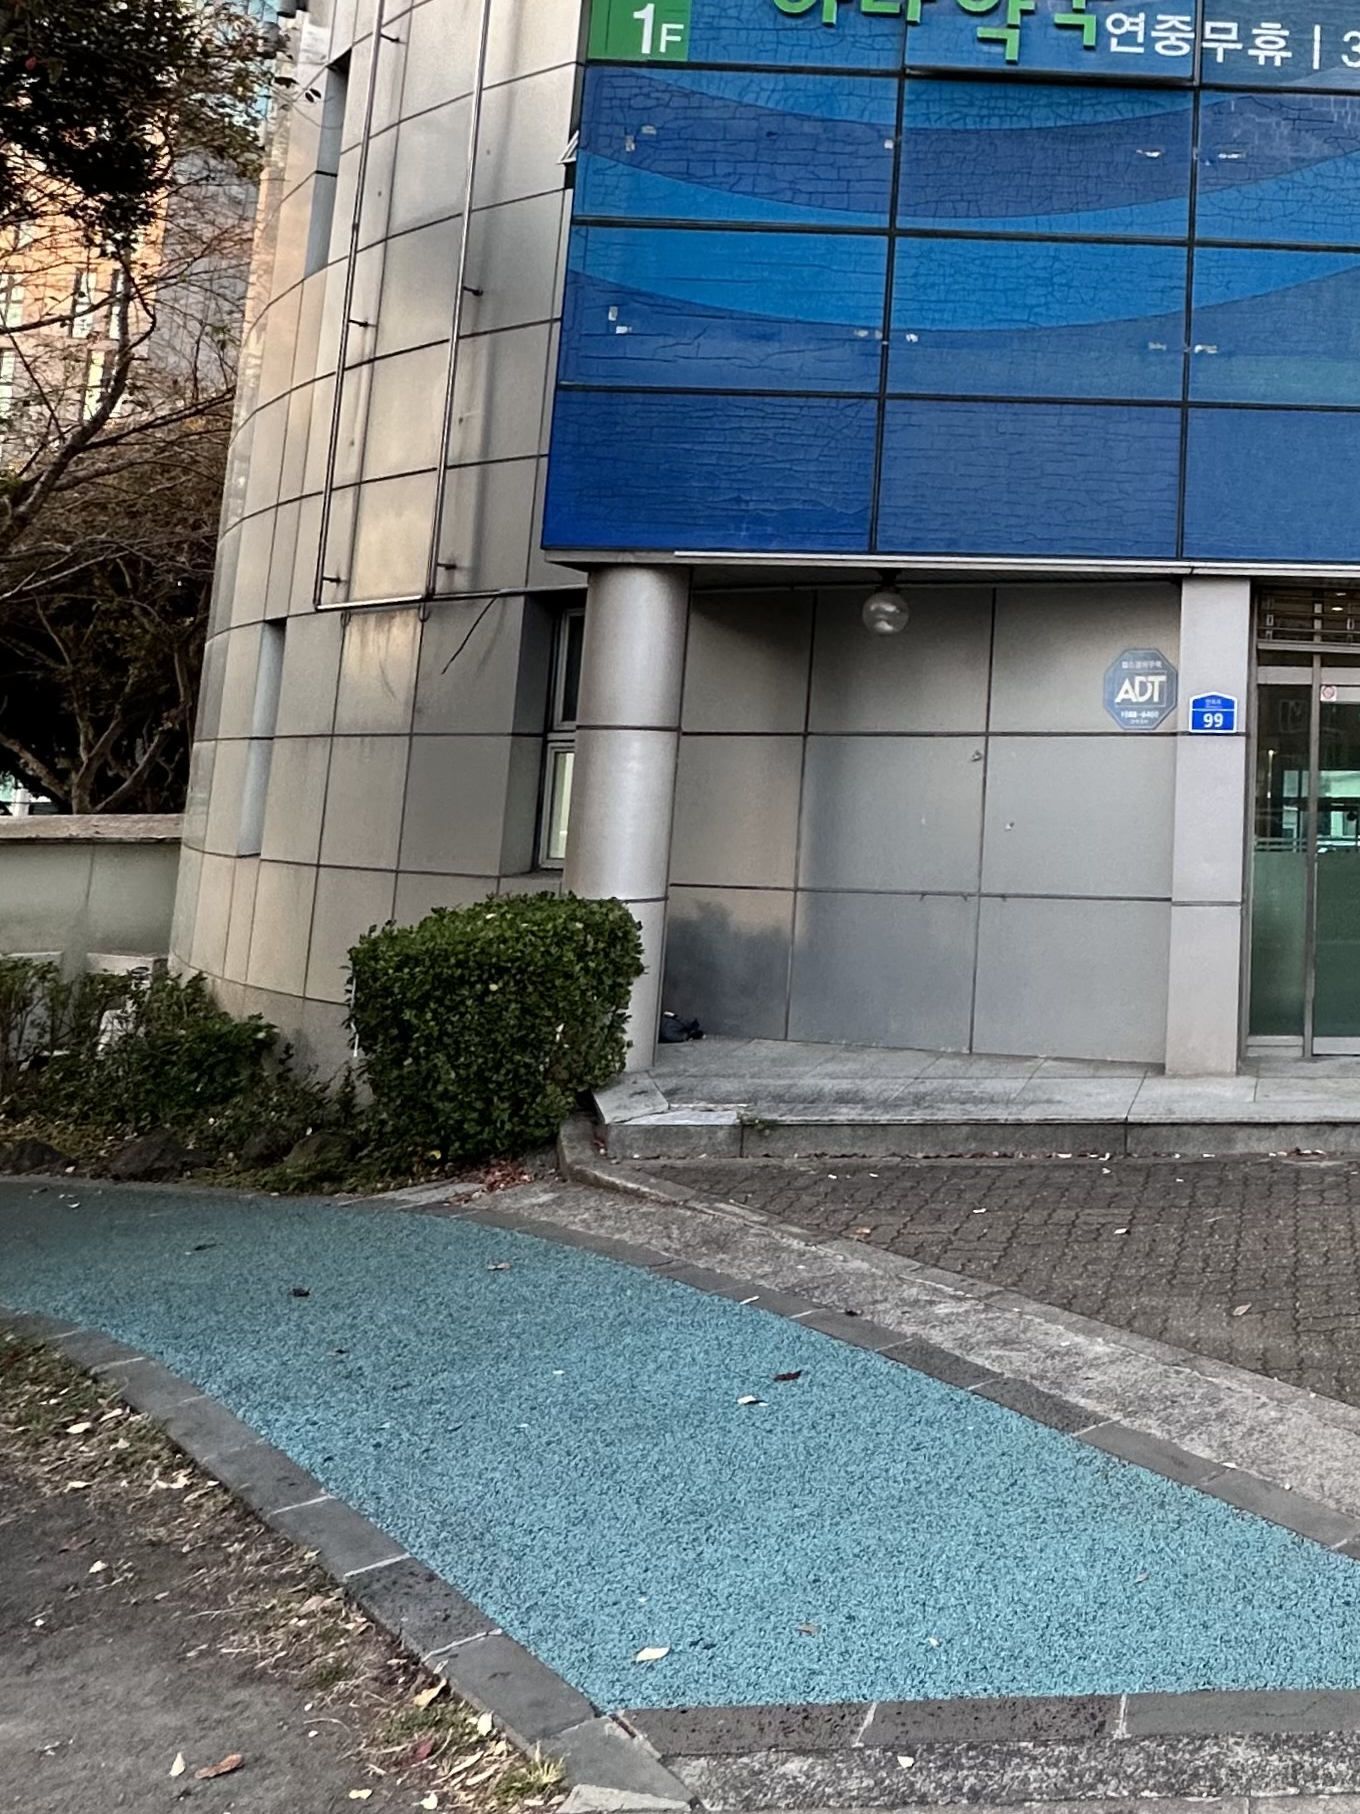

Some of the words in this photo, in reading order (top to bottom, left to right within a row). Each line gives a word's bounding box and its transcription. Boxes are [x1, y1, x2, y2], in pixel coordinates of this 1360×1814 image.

[633, 2, 685, 54] 1F
[1104, 12, 1293, 66] 연중무휴
[1114, 675, 1168, 703] ADT
[1203, 712, 1224, 728] 99
